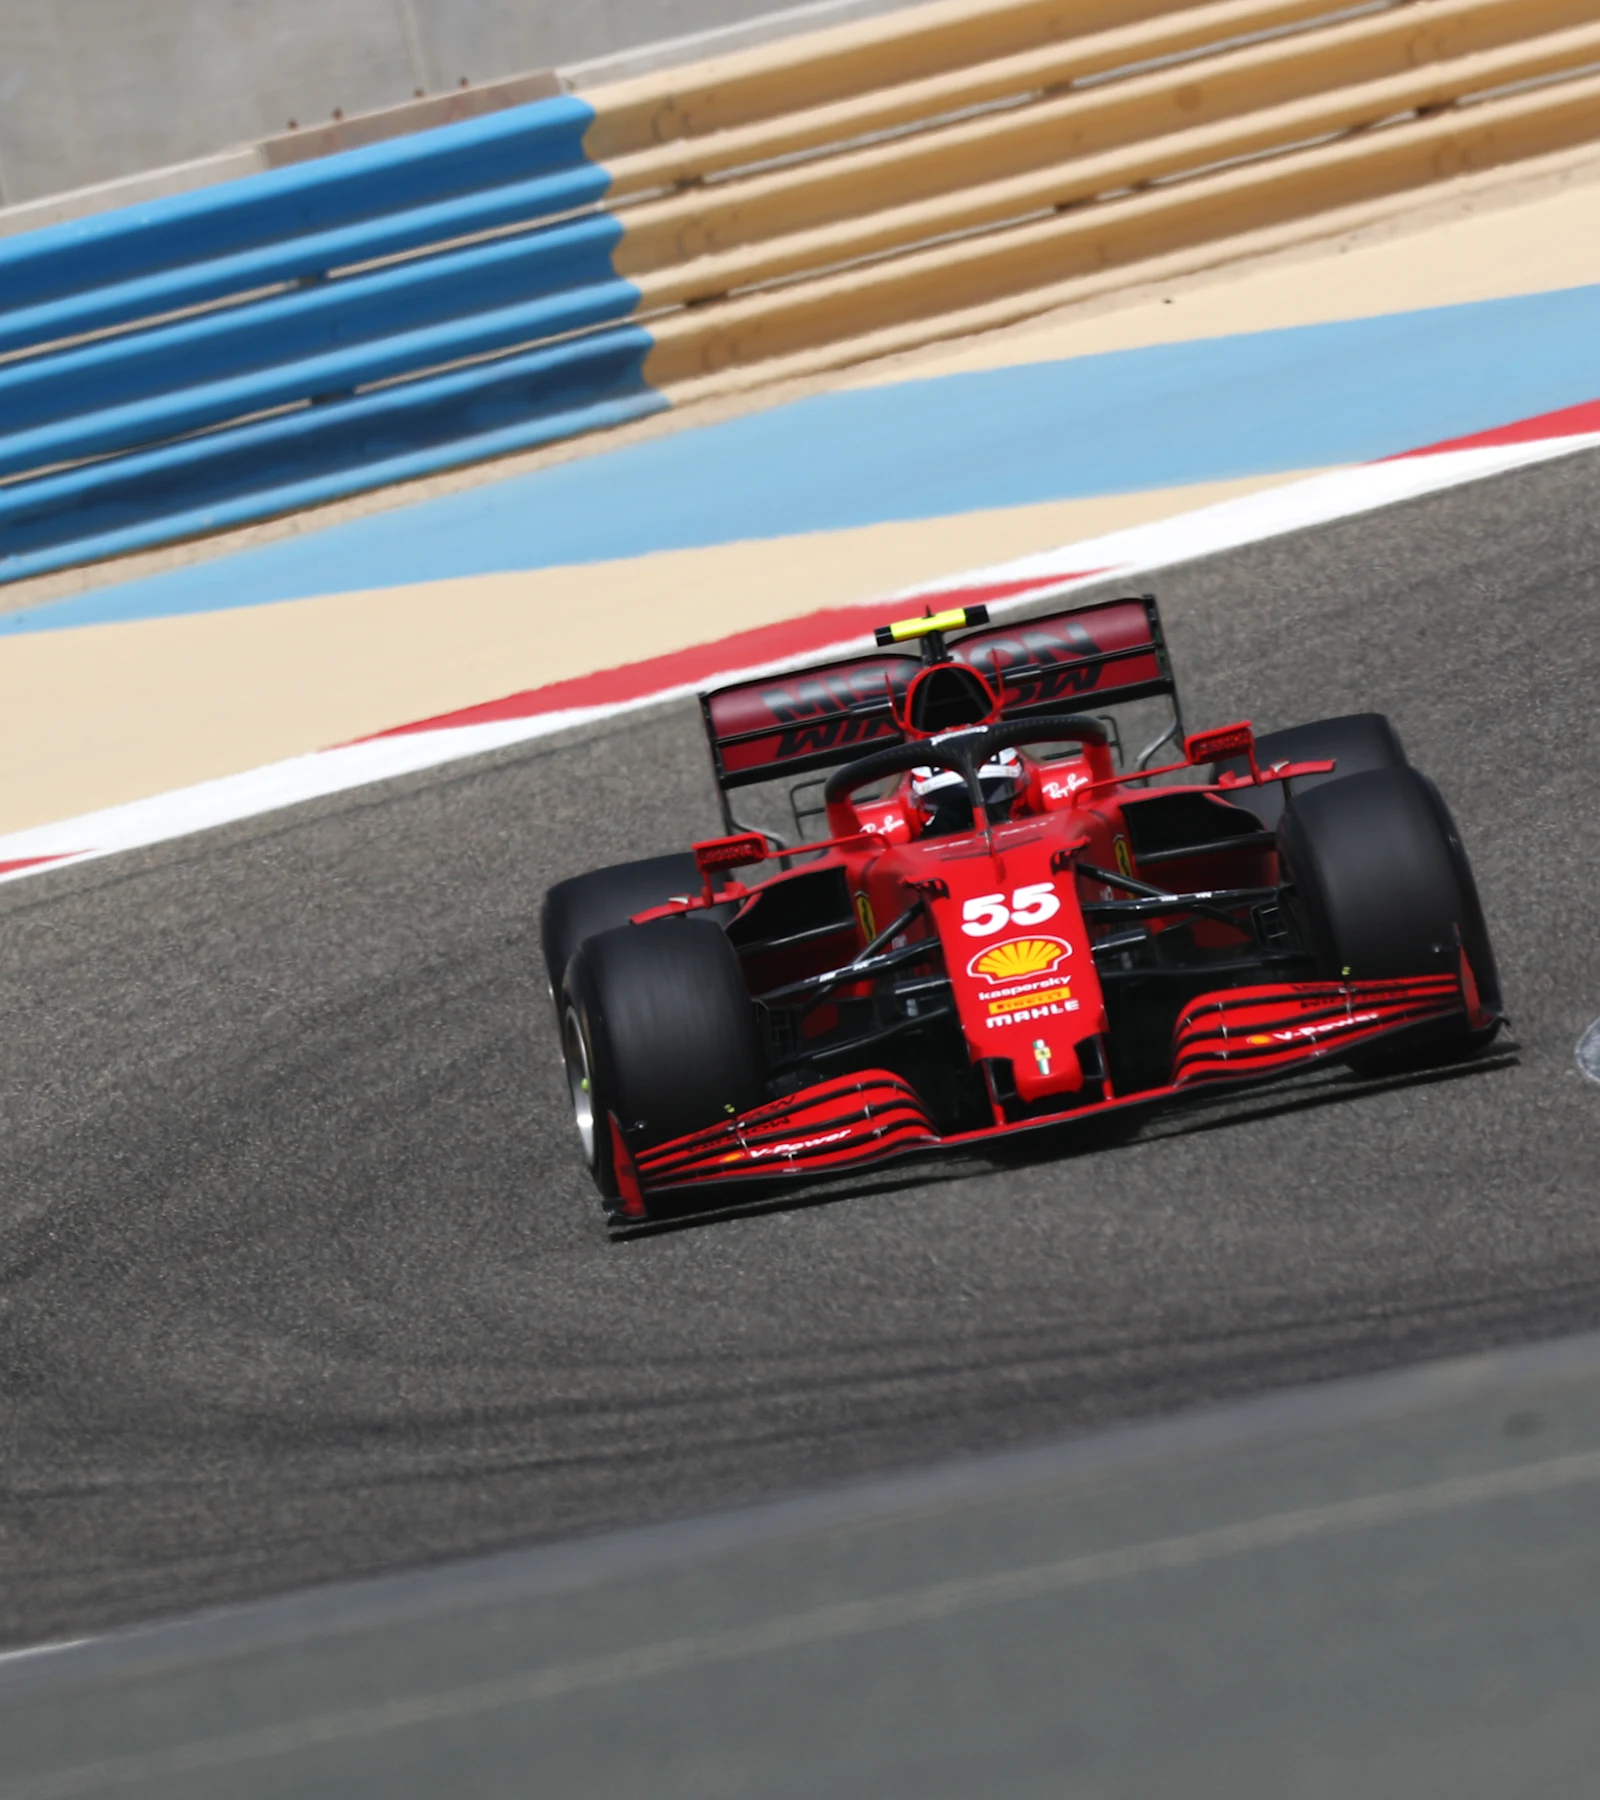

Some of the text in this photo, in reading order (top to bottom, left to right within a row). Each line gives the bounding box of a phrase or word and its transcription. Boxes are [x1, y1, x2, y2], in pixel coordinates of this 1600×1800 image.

[961, 882, 1061, 937] 55
[978, 975, 1072, 1001] kaspersky
[985, 999, 1080, 1029] MAHLE
[1272, 1012, 1379, 1041] V-Power
[751, 1129, 852, 1158] V-Power
